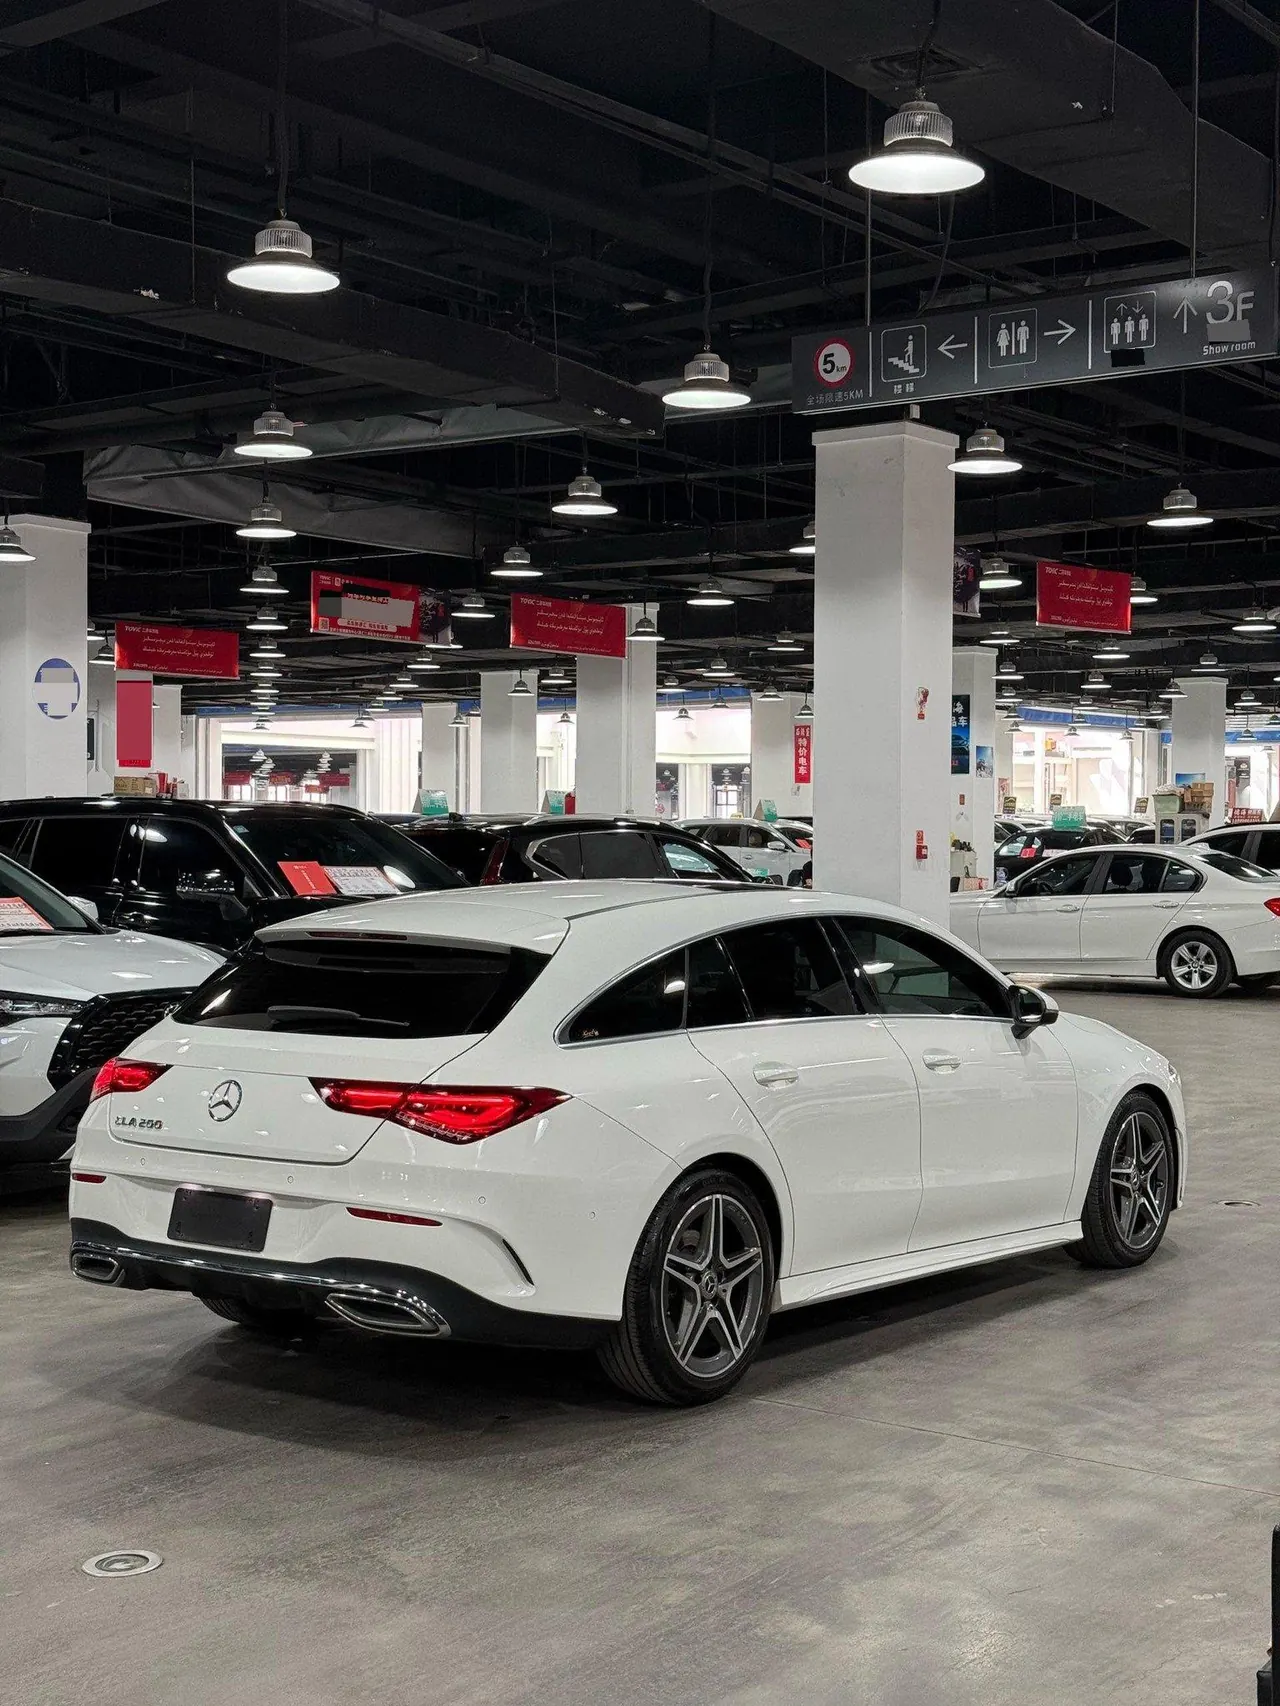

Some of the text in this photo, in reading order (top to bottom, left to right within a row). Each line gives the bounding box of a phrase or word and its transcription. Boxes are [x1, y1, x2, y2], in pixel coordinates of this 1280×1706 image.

[1206, 280, 1255, 324] 3F
[797, 737, 808, 776] 特价电车
[138, 1118, 163, 1130] 200
